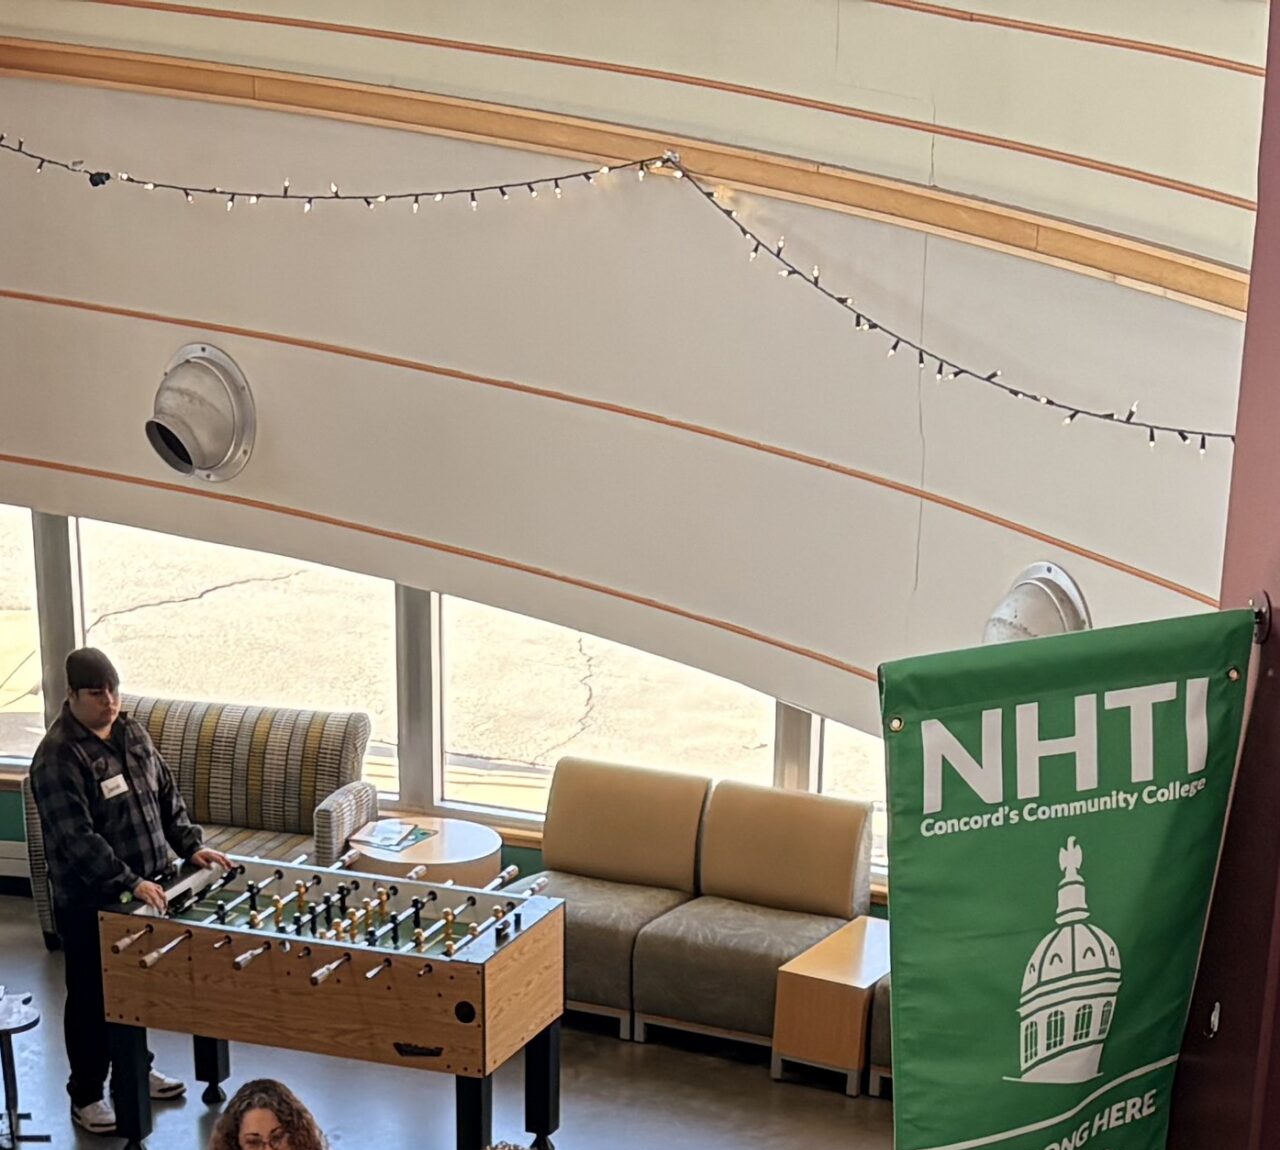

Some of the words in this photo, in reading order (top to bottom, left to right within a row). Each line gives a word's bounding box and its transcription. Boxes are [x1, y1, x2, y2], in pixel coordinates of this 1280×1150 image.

[921, 677, 1209, 814] NHTI
[920, 806, 1019, 837] Concord's
[1022, 790, 1138, 822] Community
[1142, 777, 1207, 804] College
[1092, 1089, 1157, 1137] HERE
